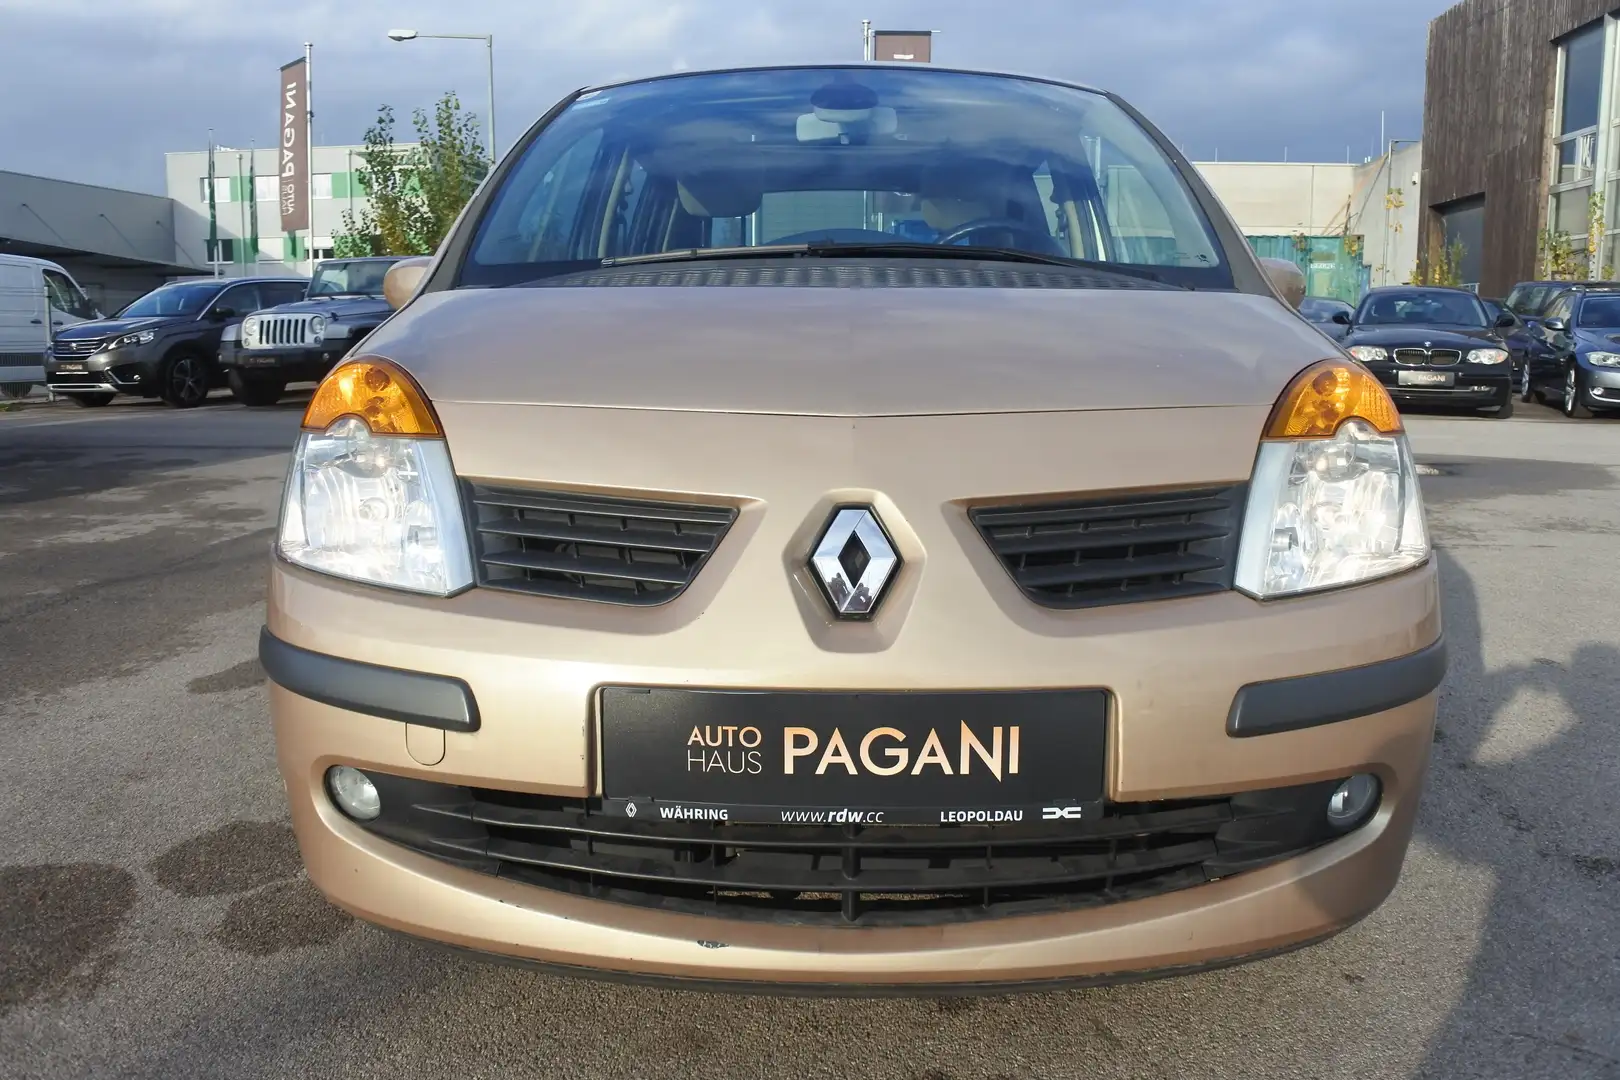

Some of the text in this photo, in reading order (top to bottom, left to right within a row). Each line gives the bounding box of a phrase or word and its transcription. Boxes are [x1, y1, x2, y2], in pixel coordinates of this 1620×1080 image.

[686, 720, 1020, 783] AUTO PAGANI
[687, 749, 762, 774] HAUS
[659, 805, 1024, 823] WÄHRING www.rdw.cc LEOPOLDAU
